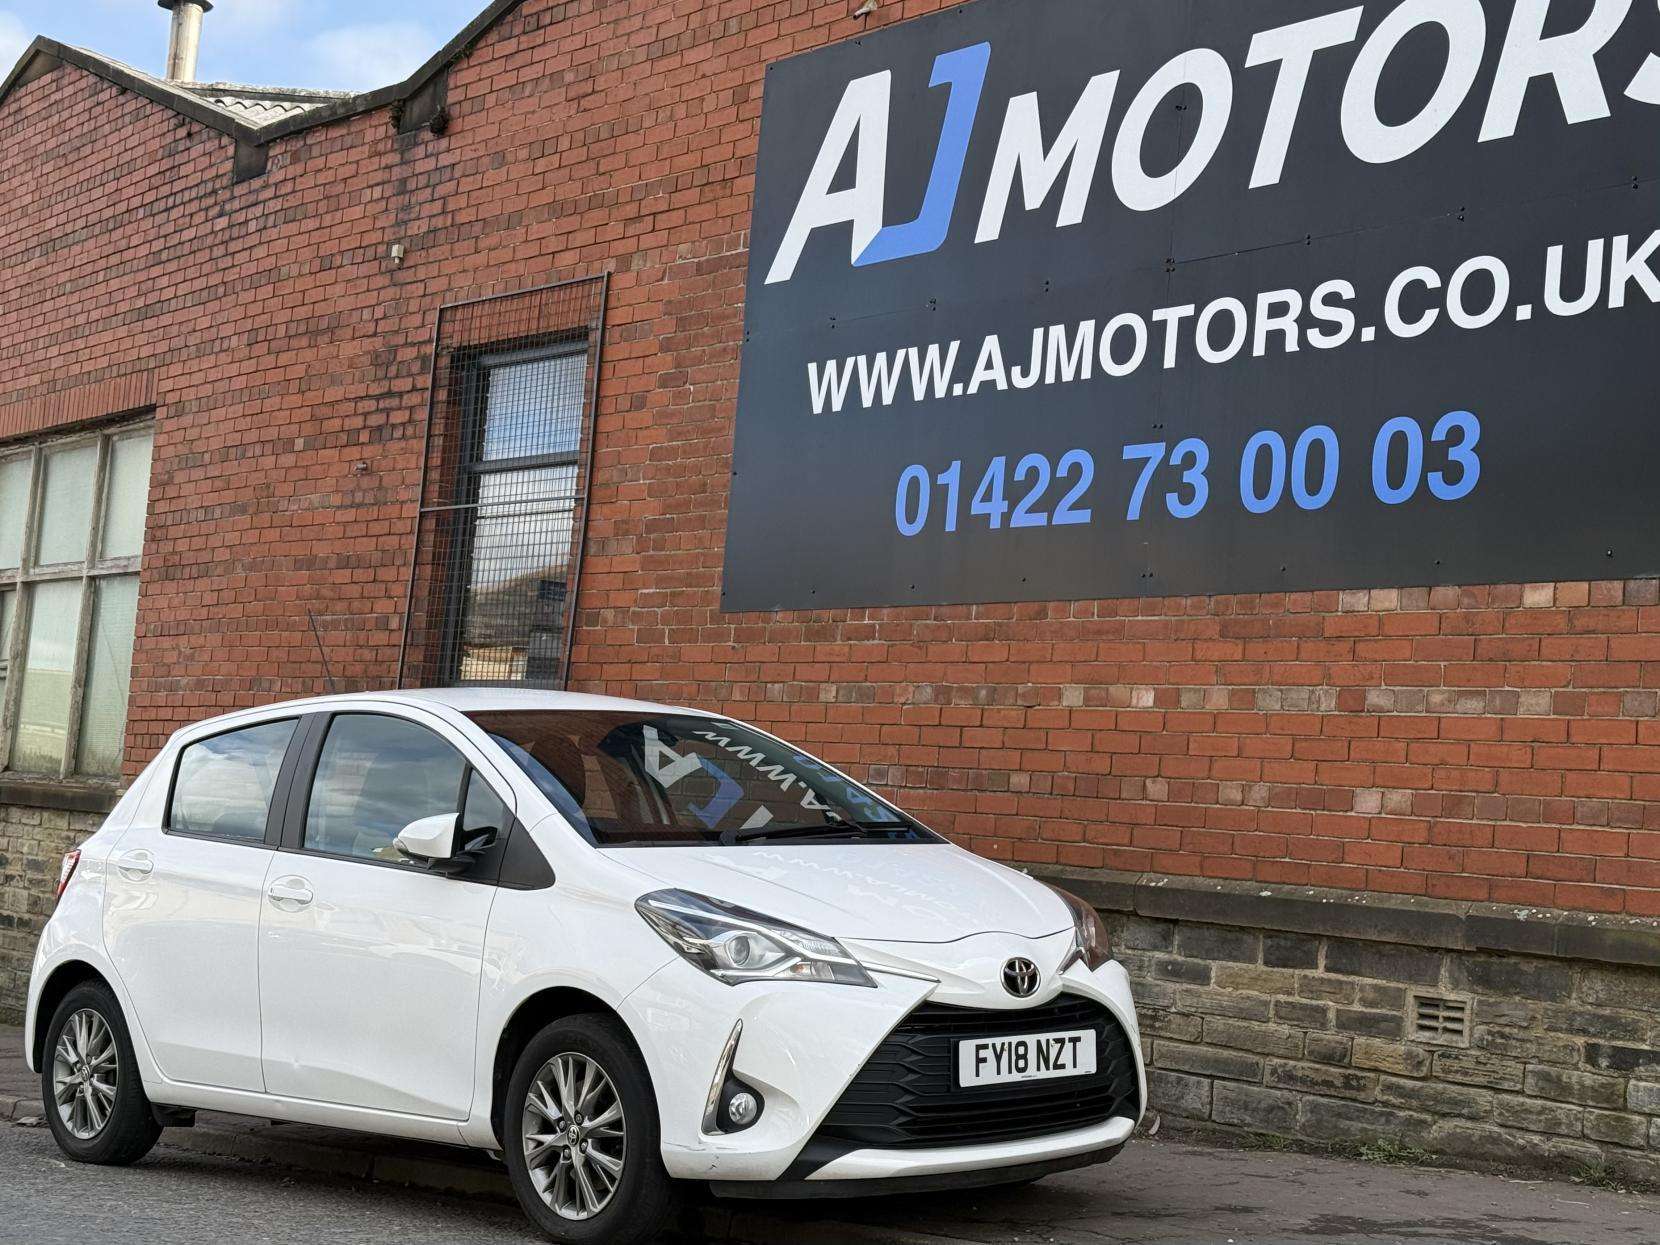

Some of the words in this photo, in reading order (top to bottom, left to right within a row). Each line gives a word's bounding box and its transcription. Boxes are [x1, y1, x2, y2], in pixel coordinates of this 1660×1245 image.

[974, 0, 1660, 244] MOTOR
[808, 229, 1660, 415] WWW.AJMOTORS.CO.UK
[896, 449, 1095, 536] 01422
[1123, 438, 1210, 521] 73
[1240, 425, 1340, 514] 00
[1372, 411, 1481, 505] 03
[975, 1041, 1029, 1078] FY18
[1036, 1037, 1082, 1072] NZT
